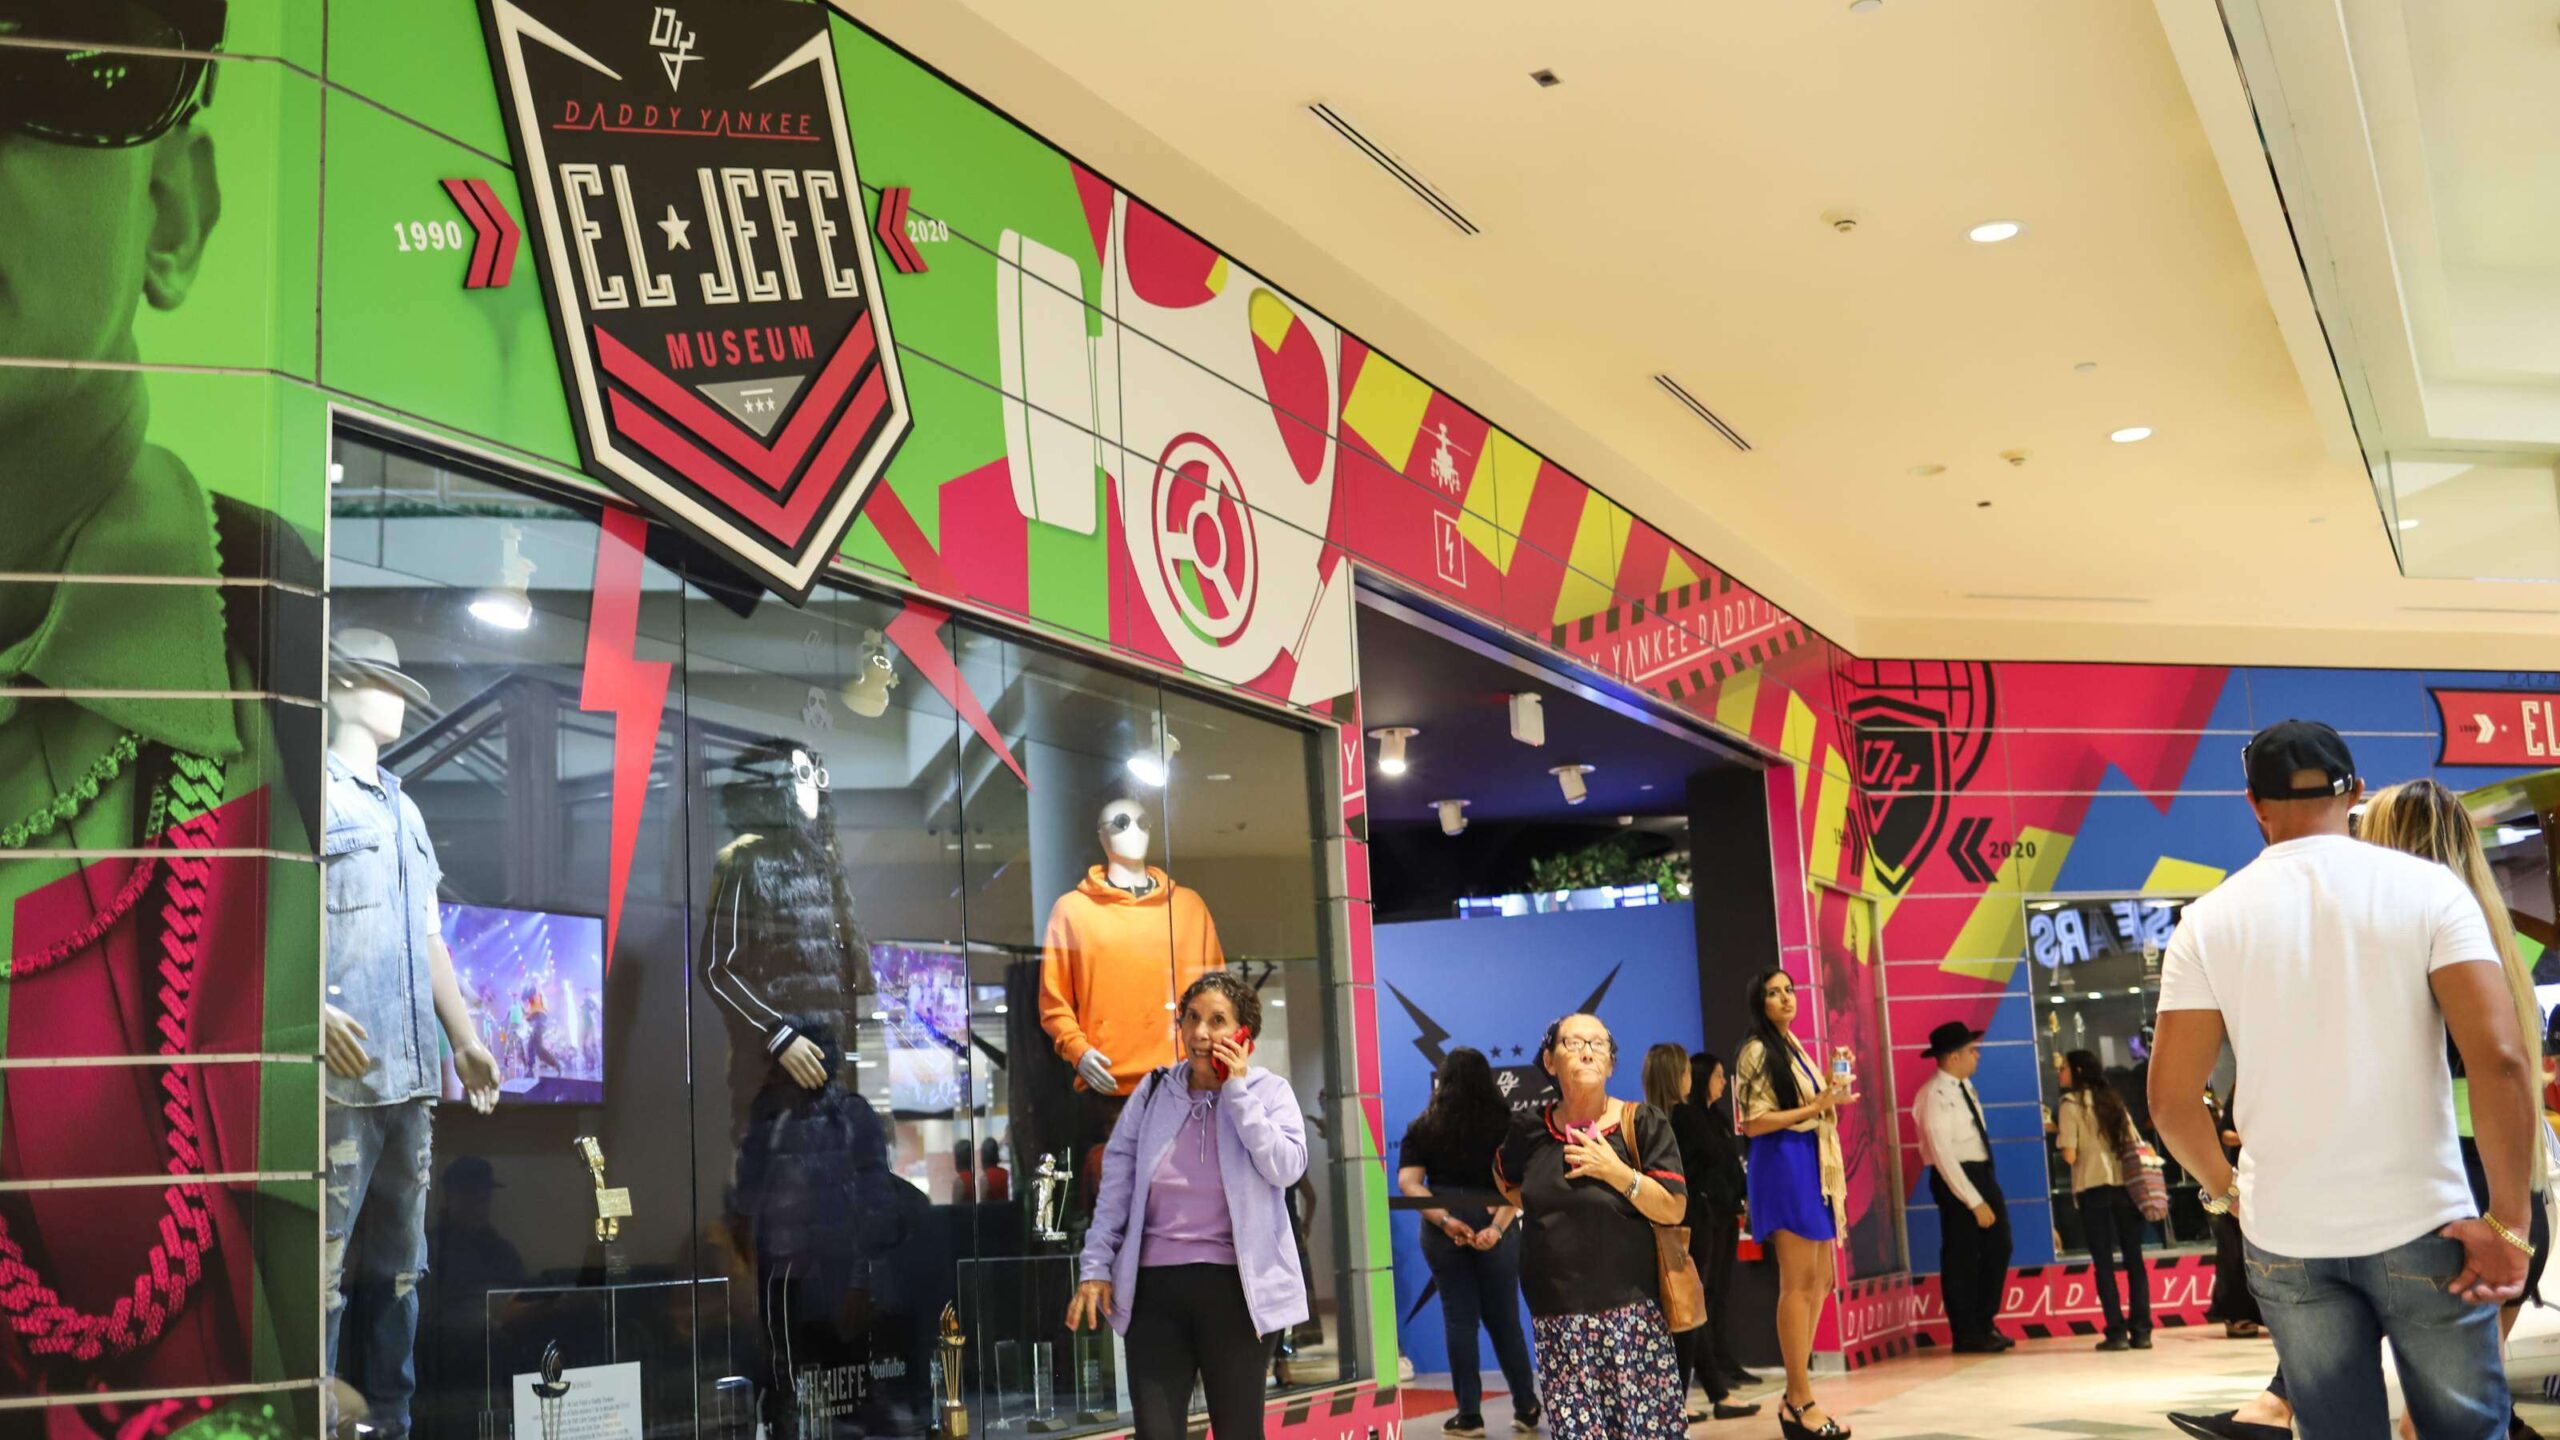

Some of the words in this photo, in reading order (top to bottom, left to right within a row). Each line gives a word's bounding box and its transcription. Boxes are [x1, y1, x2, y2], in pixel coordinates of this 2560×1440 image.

[565, 100, 681, 131] DADDY
[700, 108, 811, 136] YANKEE
[394, 221, 463, 252] 1990
[559, 163, 677, 311] EL
[697, 167, 860, 305] JEFE
[906, 219, 949, 243] 2020
[666, 325, 814, 369] MUSEUM
[1612, 620, 1689, 684] YANKEE
[1698, 597, 1757, 649] DADDY
[1989, 841, 2036, 859] 2020
[869, 1357, 906, 1380] YouTube
